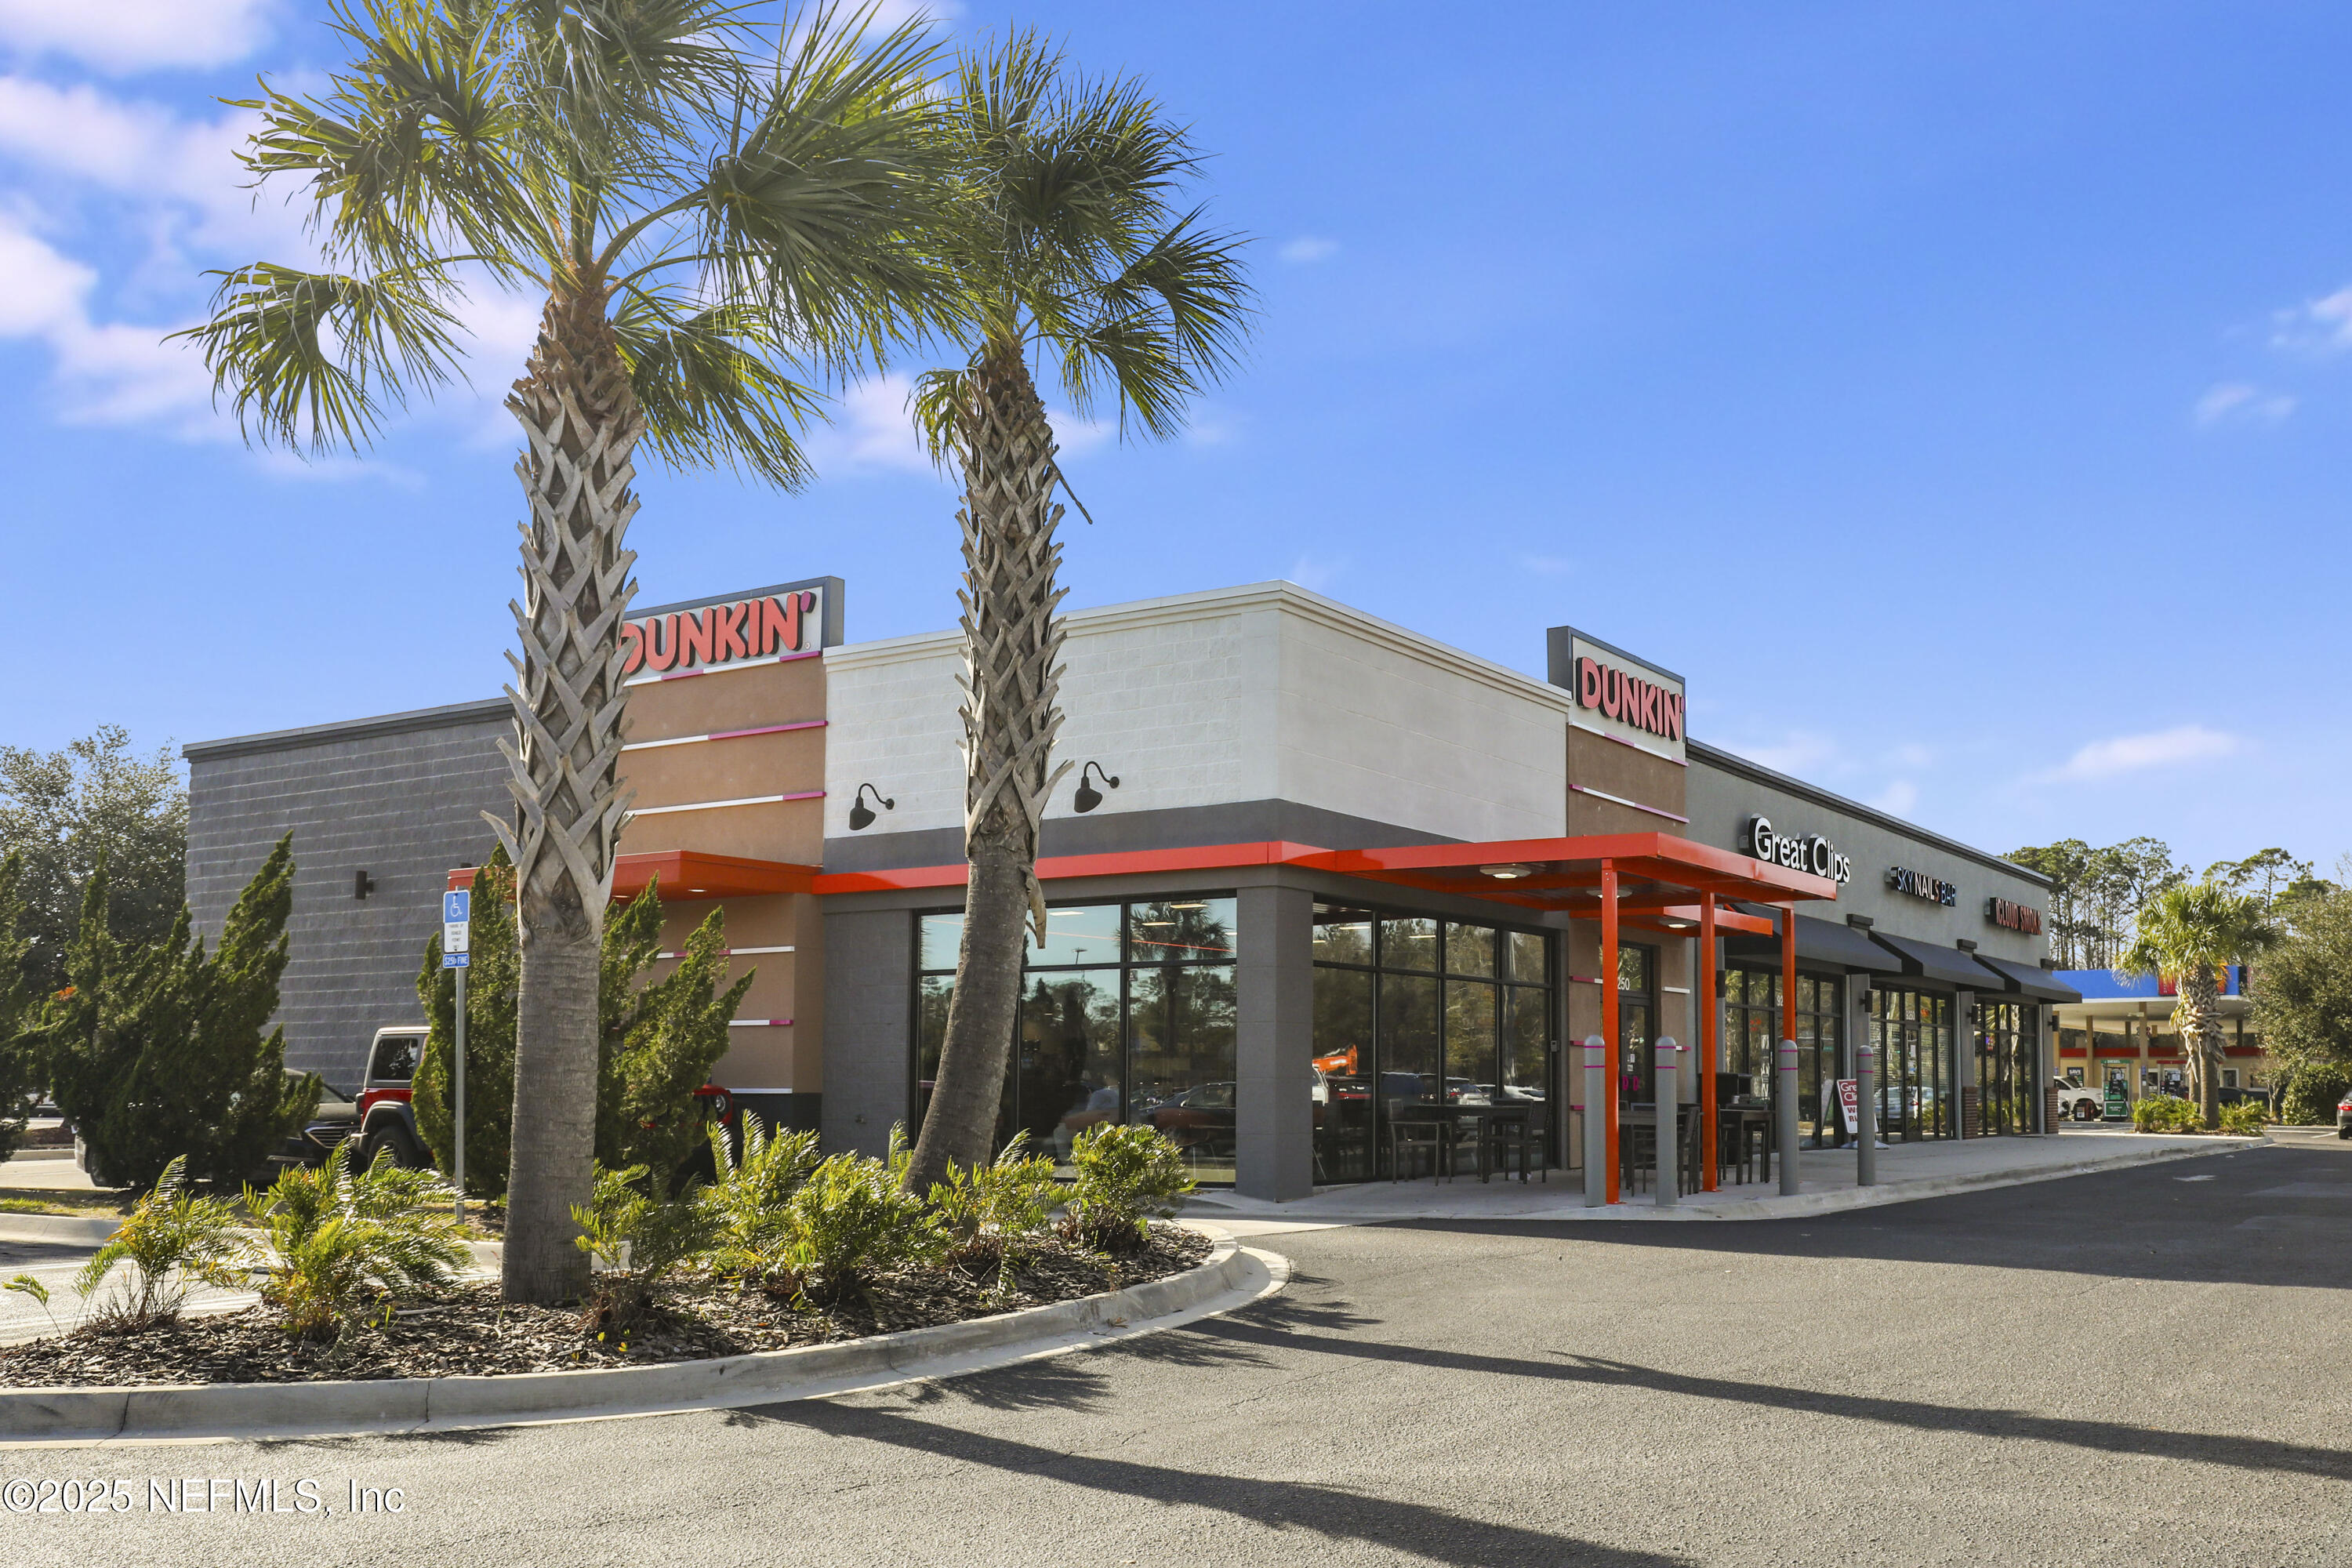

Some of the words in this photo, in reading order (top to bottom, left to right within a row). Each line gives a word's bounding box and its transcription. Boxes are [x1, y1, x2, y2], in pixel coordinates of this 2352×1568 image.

[617, 590, 816, 675] DUNKIN'
[1576, 656, 1684, 742] DUNKIN'
[1751, 816, 1808, 872] Great
[1812, 837, 1850, 884] Clips
[1896, 866, 1914, 894] SKY
[1915, 872, 1940, 902] NAILS
[1941, 881, 1957, 907] BAR
[2020, 906, 2042, 935] SMOKE
[457, 956, 468, 965] FINE
[1617, 977, 1630, 990] 250
[1840, 1082, 1857, 1091] Gre
[1844, 1092, 1857, 1102] Cli
